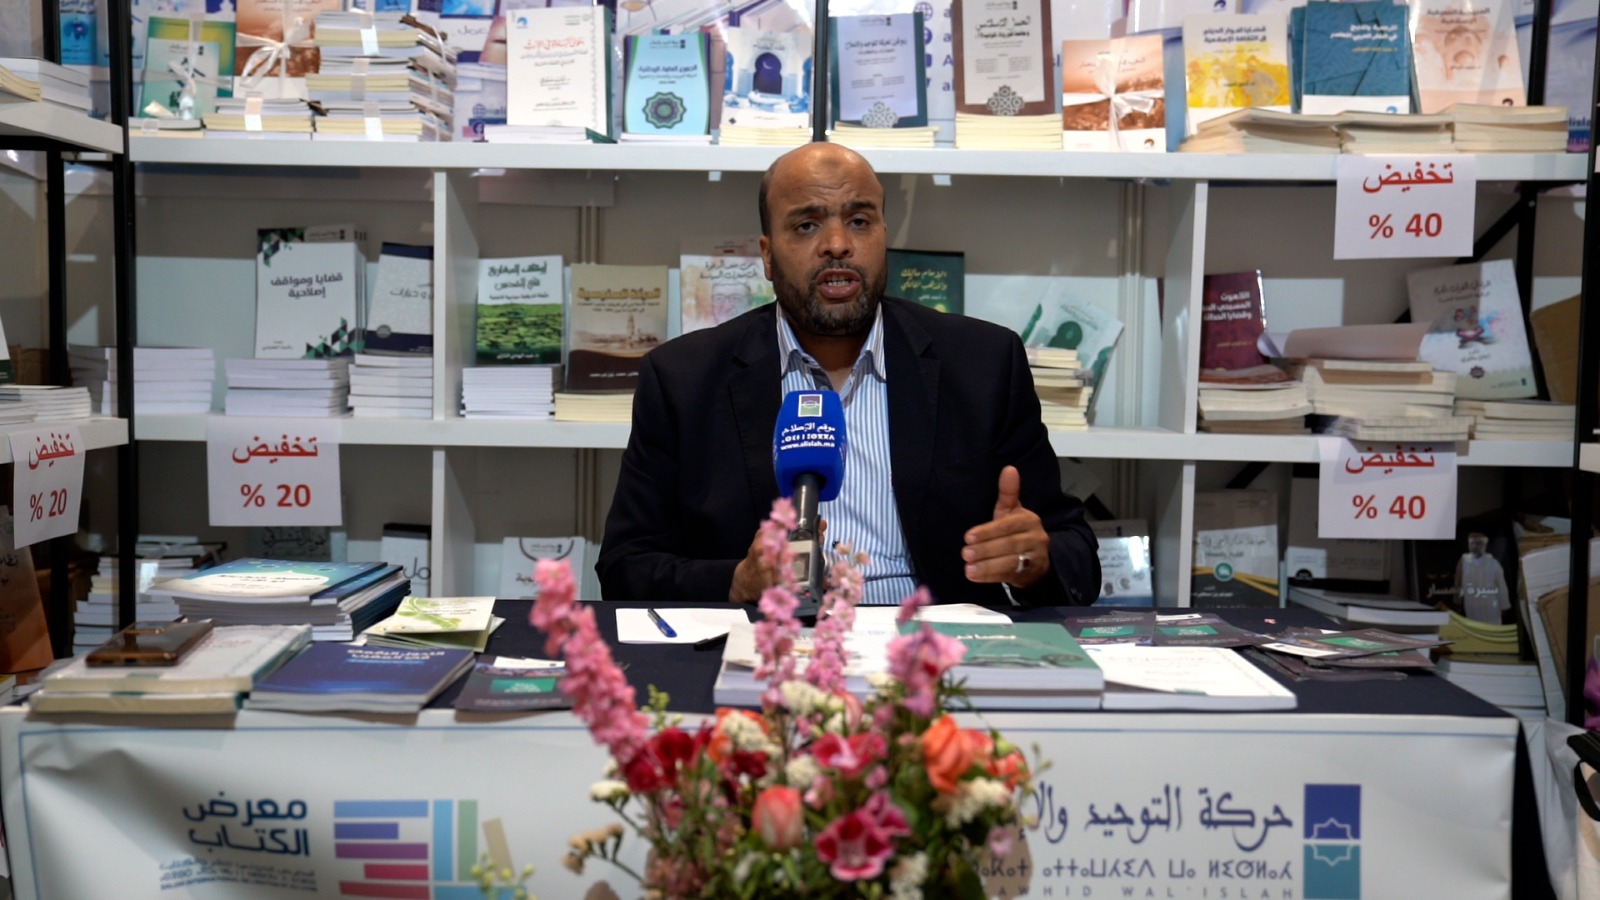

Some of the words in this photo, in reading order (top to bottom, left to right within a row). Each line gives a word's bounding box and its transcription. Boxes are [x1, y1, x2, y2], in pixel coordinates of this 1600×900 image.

[1363, 161, 1454, 194] تخفيض
[1368, 213, 1395, 239] %
[1405, 212, 1443, 239] 40
[270, 276, 313, 289] ومواقف
[315, 273, 343, 285] قضايا
[287, 287, 326, 299] إصلاحية
[781, 422, 815, 437] الإصلاح
[817, 424, 836, 433] موقع
[28, 432, 76, 471] تخفيض
[231, 433, 319, 465] تخفيض
[780, 440, 835, 451] www.alislah.ma
[1345, 445, 1436, 475] تخفيض
[29, 491, 44, 523] %
[48, 487, 68, 518] 20
[240, 483, 266, 508] %
[276, 483, 312, 508] 20
[1351, 494, 1379, 520] %
[1388, 494, 1427, 520] 40
[1466, 582, 1499, 598] سيرة
[182, 790, 308, 827] معرض
[1084, 784, 1182, 844] التوحيد
[1199, 786, 1293, 852] حركة
[188, 824, 311, 858] الكتاب
[998, 886, 1093, 897] AWHID
[1121, 886, 1294, 899] WAL'ISLAH
